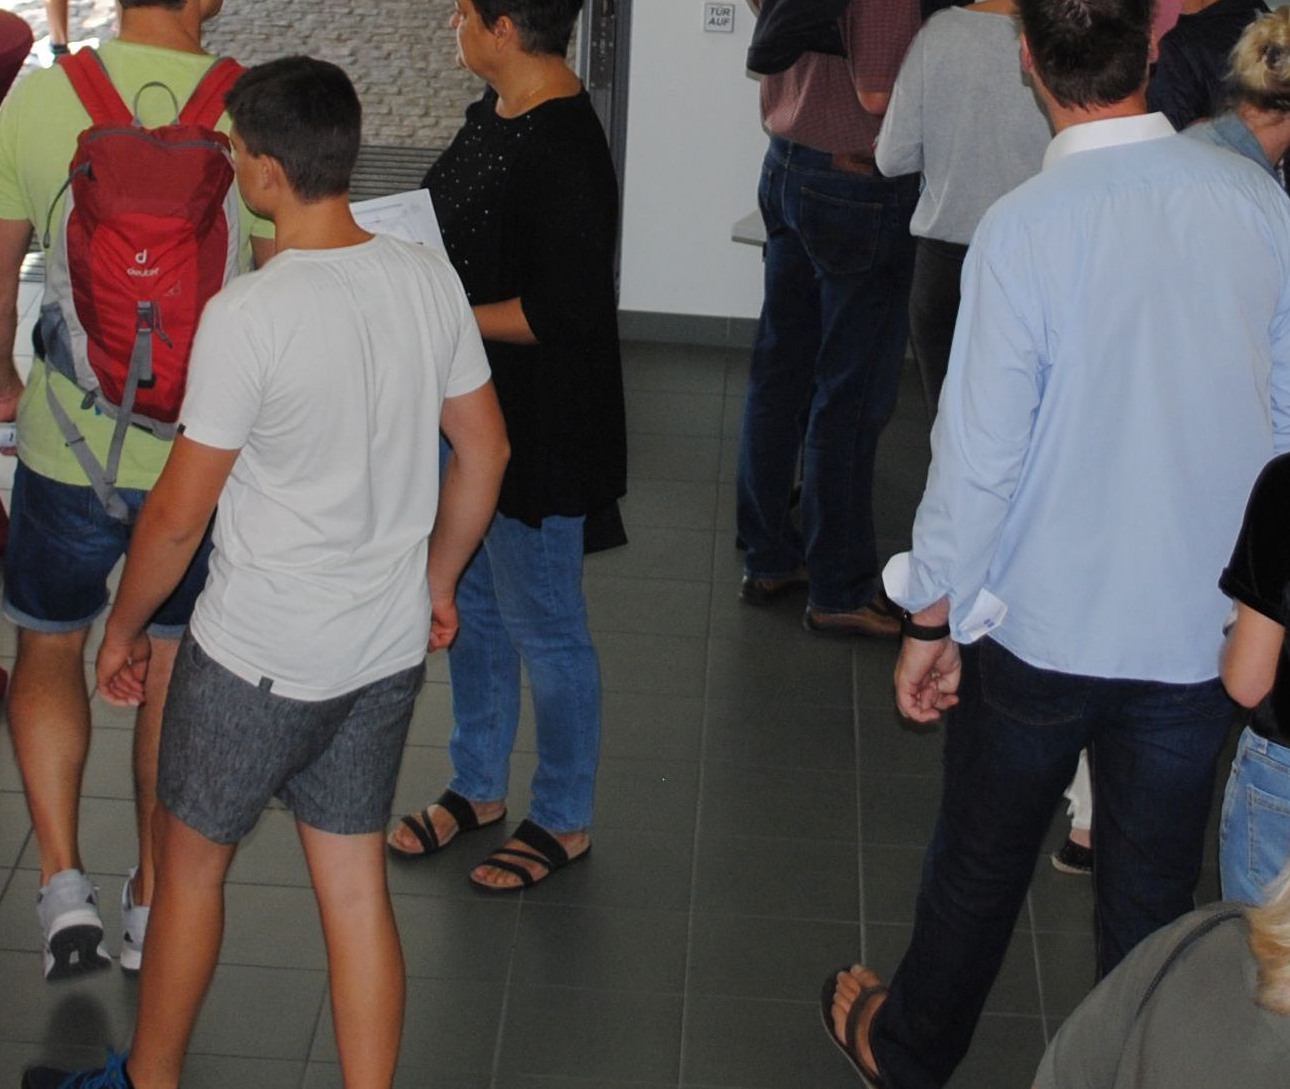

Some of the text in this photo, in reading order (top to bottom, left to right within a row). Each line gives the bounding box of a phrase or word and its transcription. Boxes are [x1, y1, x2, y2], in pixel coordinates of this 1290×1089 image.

[710, 5, 731, 17] TÜR
[708, 17, 731, 27] AUF
[126, 267, 160, 277] deuter
